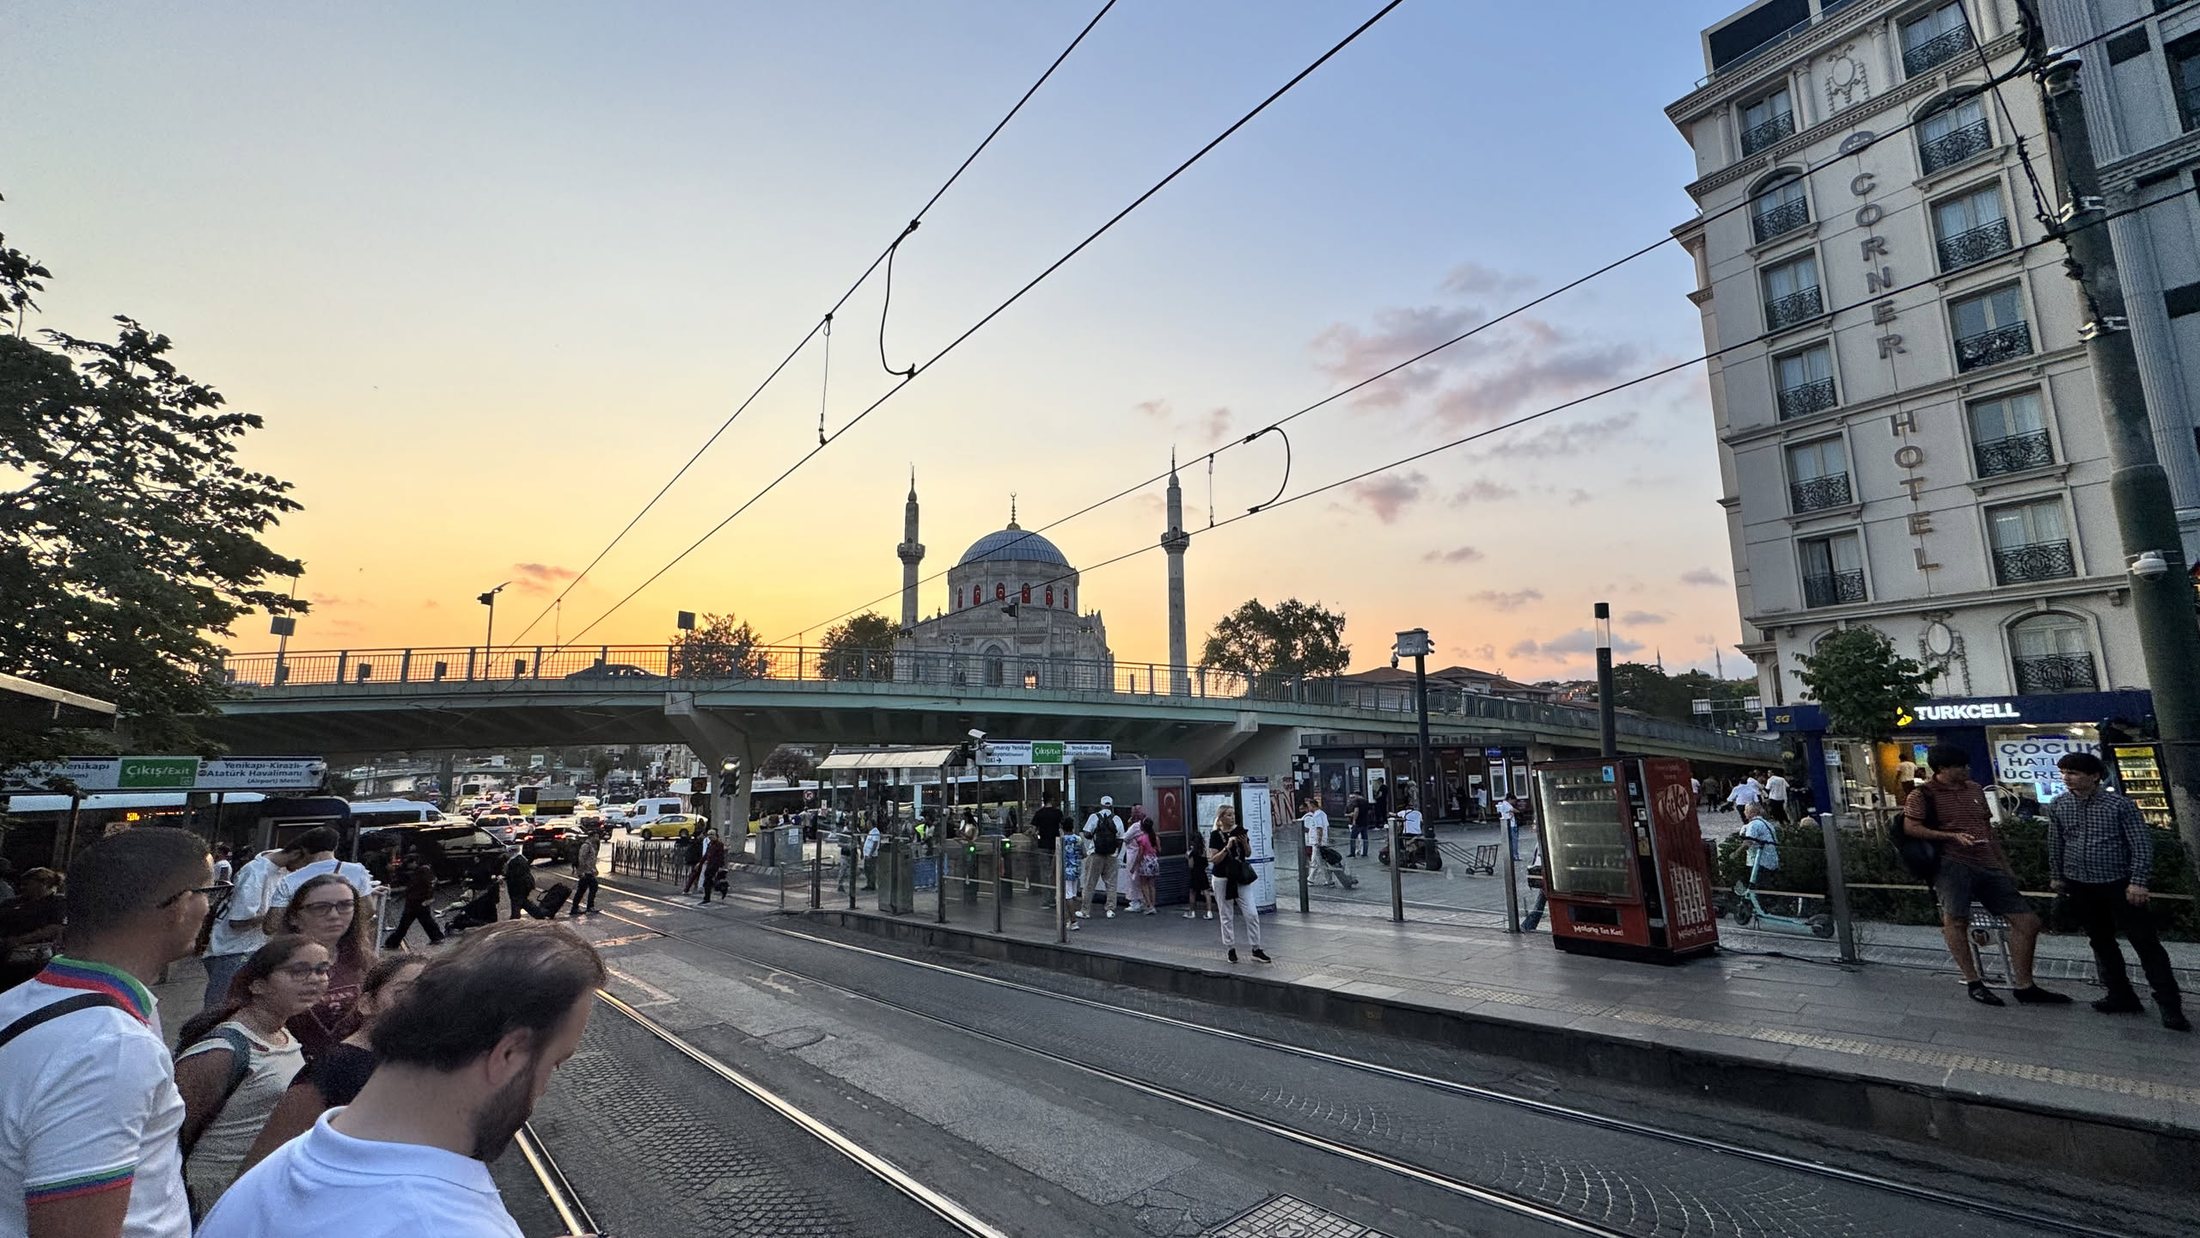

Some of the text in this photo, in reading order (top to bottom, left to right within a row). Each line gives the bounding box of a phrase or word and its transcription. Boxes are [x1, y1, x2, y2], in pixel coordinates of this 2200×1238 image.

[1850, 172, 1907, 360] CORNER
[1889, 409, 1940, 571] HOTEL
[1914, 703, 2021, 721] TURKCELL
[1775, 715, 1791, 724] 5G
[2000, 743, 2102, 758] ÇOCUK
[126, 765, 190, 777] Çıkış/Exit
[206, 769, 246, 777] Atatürk
